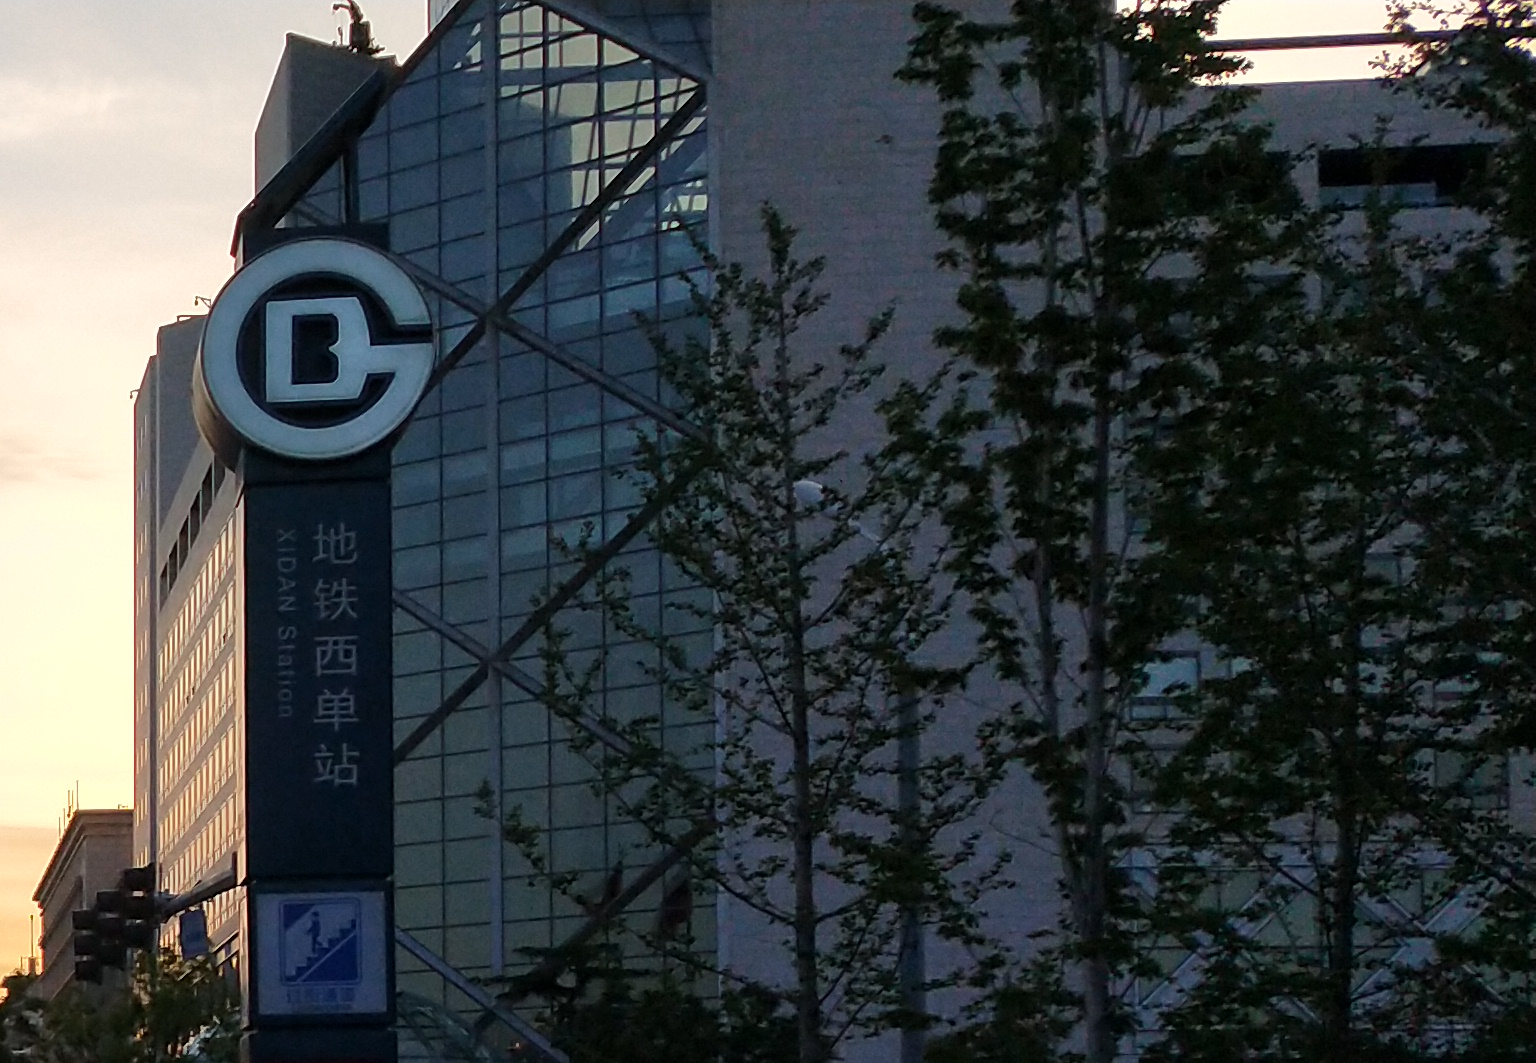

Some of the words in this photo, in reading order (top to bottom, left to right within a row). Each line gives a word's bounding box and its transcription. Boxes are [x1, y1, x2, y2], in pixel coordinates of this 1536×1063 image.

[277, 528, 296, 612] XIDAN
[277, 625, 297, 718] Station
[312, 522, 359, 786] 地铁西单站
